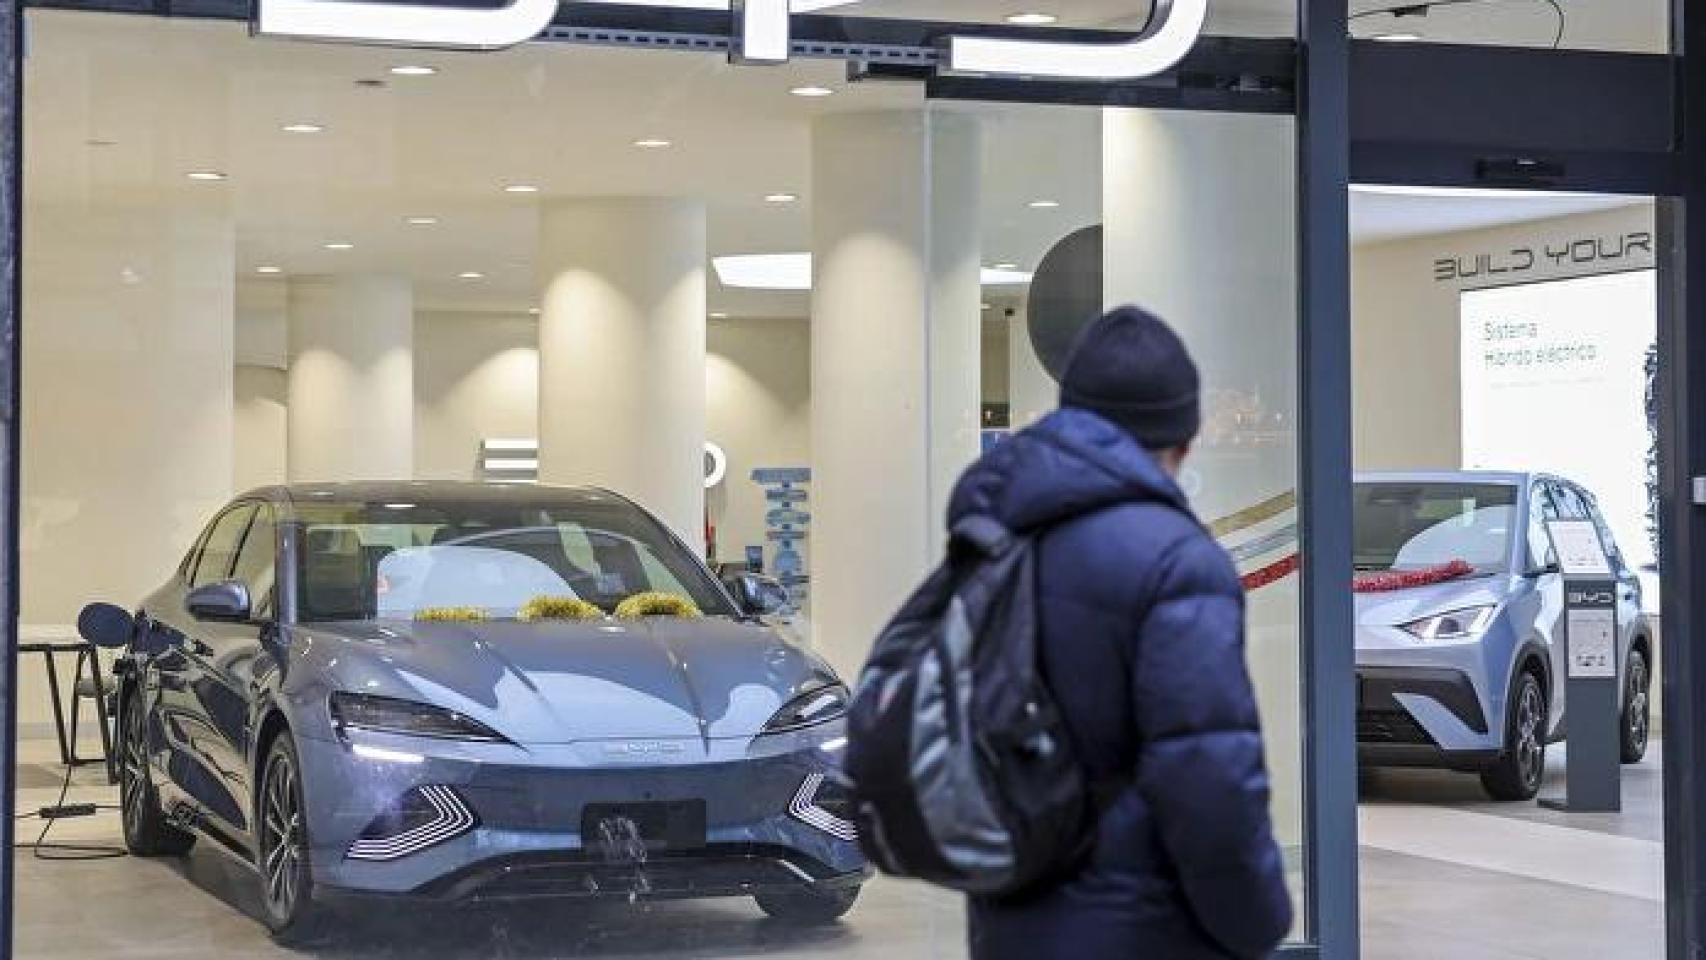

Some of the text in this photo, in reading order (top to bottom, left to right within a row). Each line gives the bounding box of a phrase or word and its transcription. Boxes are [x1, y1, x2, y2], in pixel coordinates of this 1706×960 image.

[1433, 232, 1651, 281] BUILD YOUR
[1568, 591, 1614, 604] BYD
